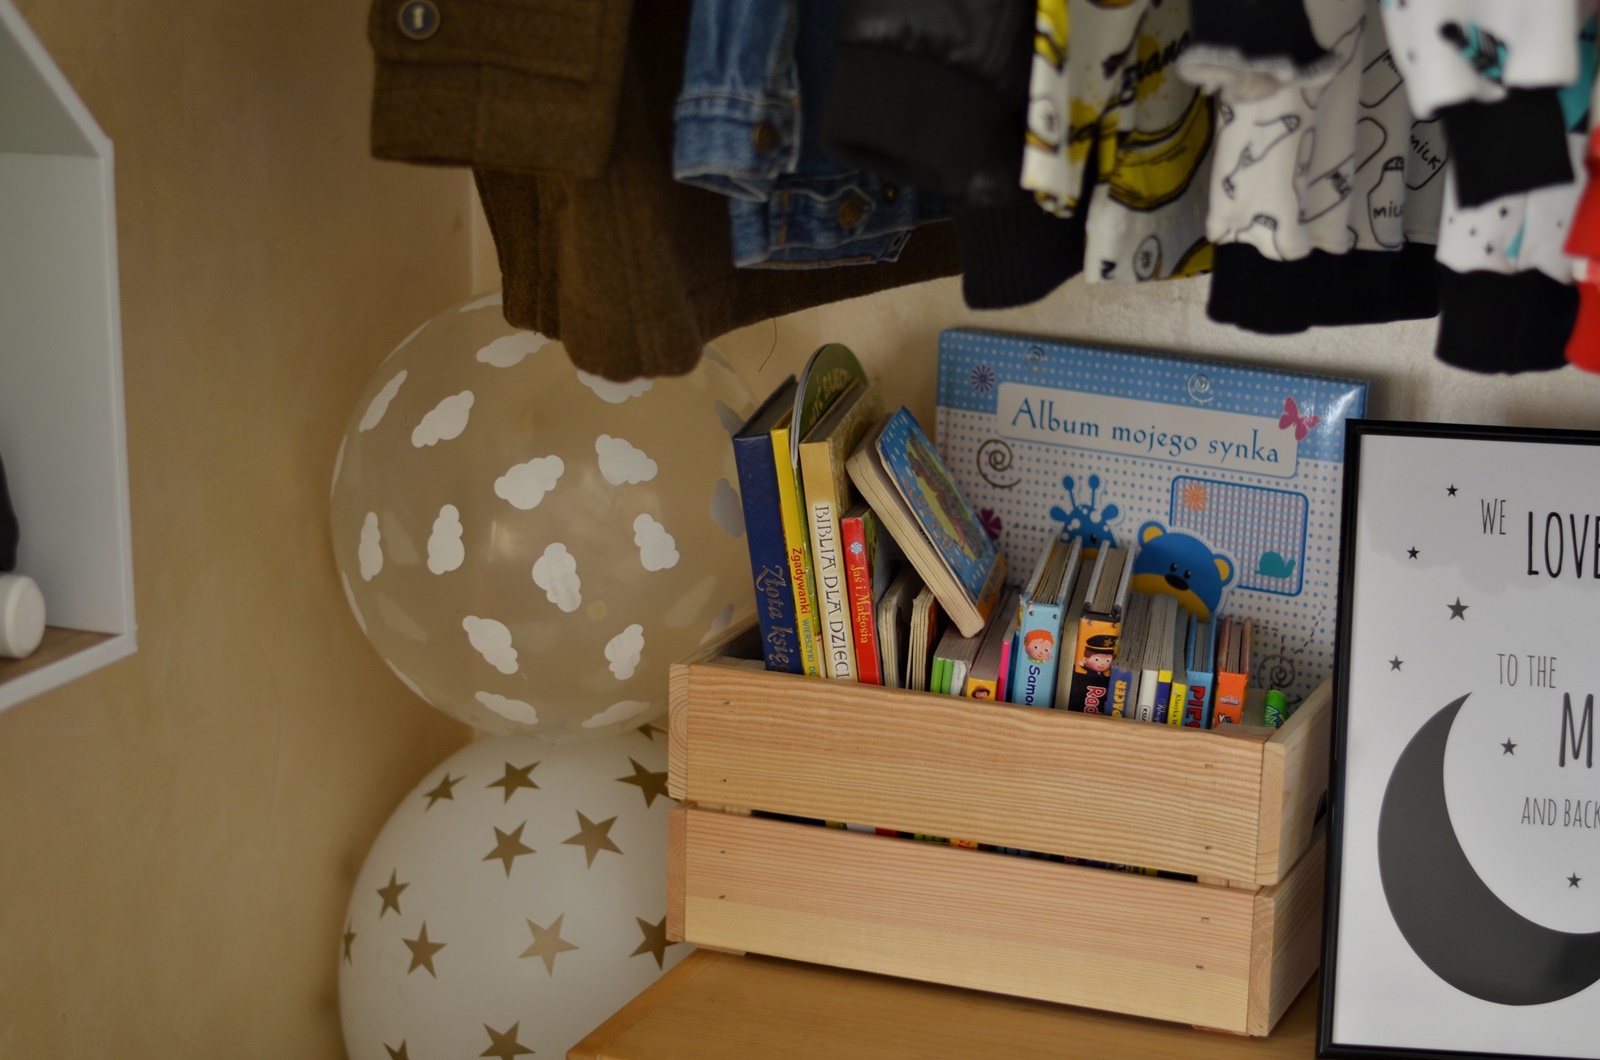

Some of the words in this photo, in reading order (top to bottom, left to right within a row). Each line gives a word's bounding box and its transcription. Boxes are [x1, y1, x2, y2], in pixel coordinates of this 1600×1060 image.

[1011, 397, 1099, 438] Album
[1111, 425, 1198, 457] mojego
[1208, 428, 1279, 463] synka
[815, 505, 837, 572] BIBLIA
[1481, 498, 1506, 535] WE
[1527, 511, 1600, 579] LOVE
[756, 565, 786, 619] Złota
[791, 548, 811, 614] Zgadywanki
[823, 575, 842, 616] DLA
[850, 565, 866, 590] Jaś
[802, 618, 815, 662] WIERSZYKI
[854, 591, 872, 644] Małgosia
[829, 620, 850, 679] DZIECI
[1497, 653, 1518, 686] TO
[1527, 655, 1557, 688] THE
[1521, 797, 1557, 826] AND
[1563, 799, 1600, 829] BACK
